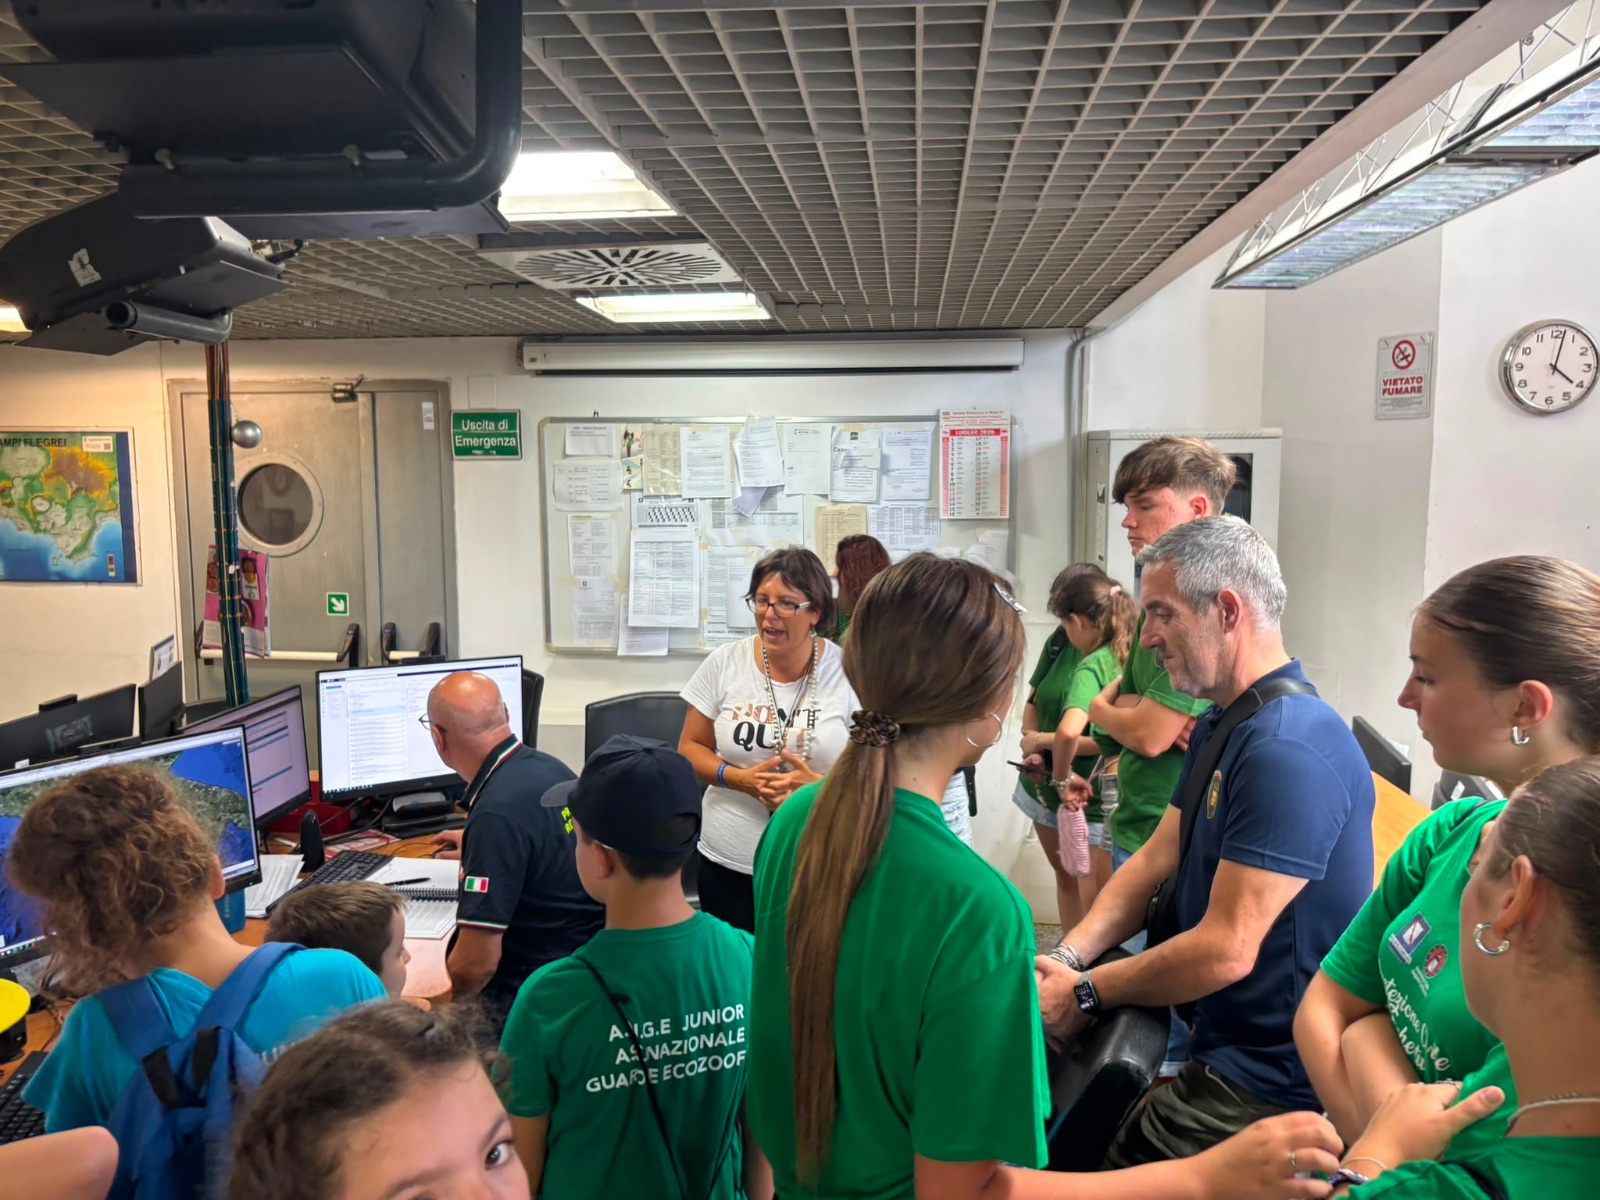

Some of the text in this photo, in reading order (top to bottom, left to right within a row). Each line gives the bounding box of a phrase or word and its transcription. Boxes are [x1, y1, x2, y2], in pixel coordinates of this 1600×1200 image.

[1536, 334, 1544, 343] 11
[1551, 330, 1563, 339] 12
[1522, 347, 1531, 356] 10
[1579, 347, 1589, 356] 2
[1515, 363, 1524, 371] 9
[1582, 363, 1592, 373] 3
[1382, 376, 1423, 386] VIETATO
[1518, 380, 1527, 388] 8
[1576, 380, 1584, 389] 4
[1382, 386, 1423, 396] FUMARE
[1529, 391, 1537, 400] 7
[1545, 396, 1554, 405] 6
[1562, 392, 1572, 401] 5
[461, 419, 509, 431] Uscita di
[0, 438, 67, 447] AMPI FLEGREI
[455, 435, 516, 449] Emergenza
[682, 1004, 745, 1031] JUNIOR
[586, 1050, 747, 1092] GUARDE ECOZOOF
